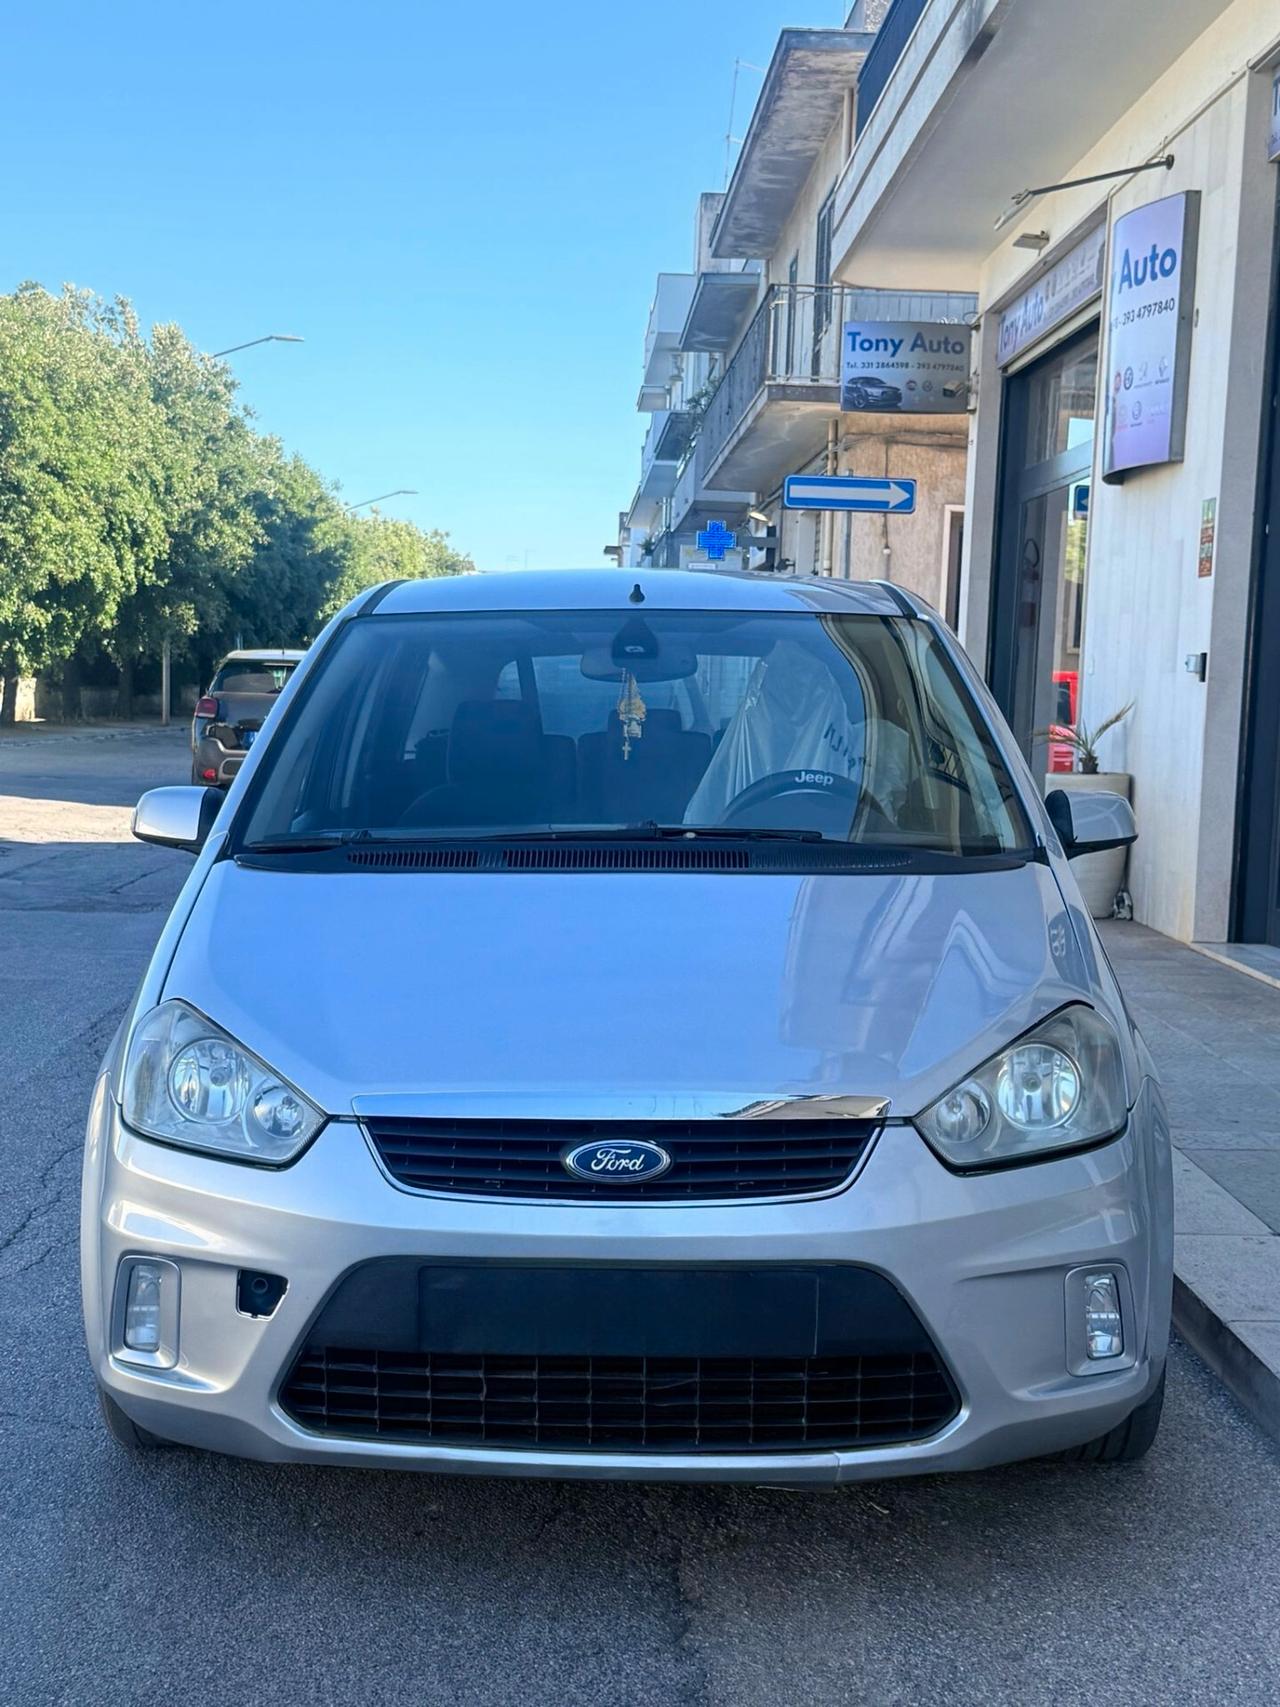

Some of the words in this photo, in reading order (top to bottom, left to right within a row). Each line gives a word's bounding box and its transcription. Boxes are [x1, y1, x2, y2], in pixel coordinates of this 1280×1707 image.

[1118, 243, 1177, 294] Auto
[1000, 314, 1019, 353] Tony
[1020, 291, 1044, 336] Auto
[1122, 310, 1135, 326] 393
[1136, 297, 1175, 319] 4797840
[847, 332, 904, 357] Tony
[910, 332, 965, 355] Auto
[794, 770, 834, 786] Jeep
[591, 1148, 645, 1171] Ford
